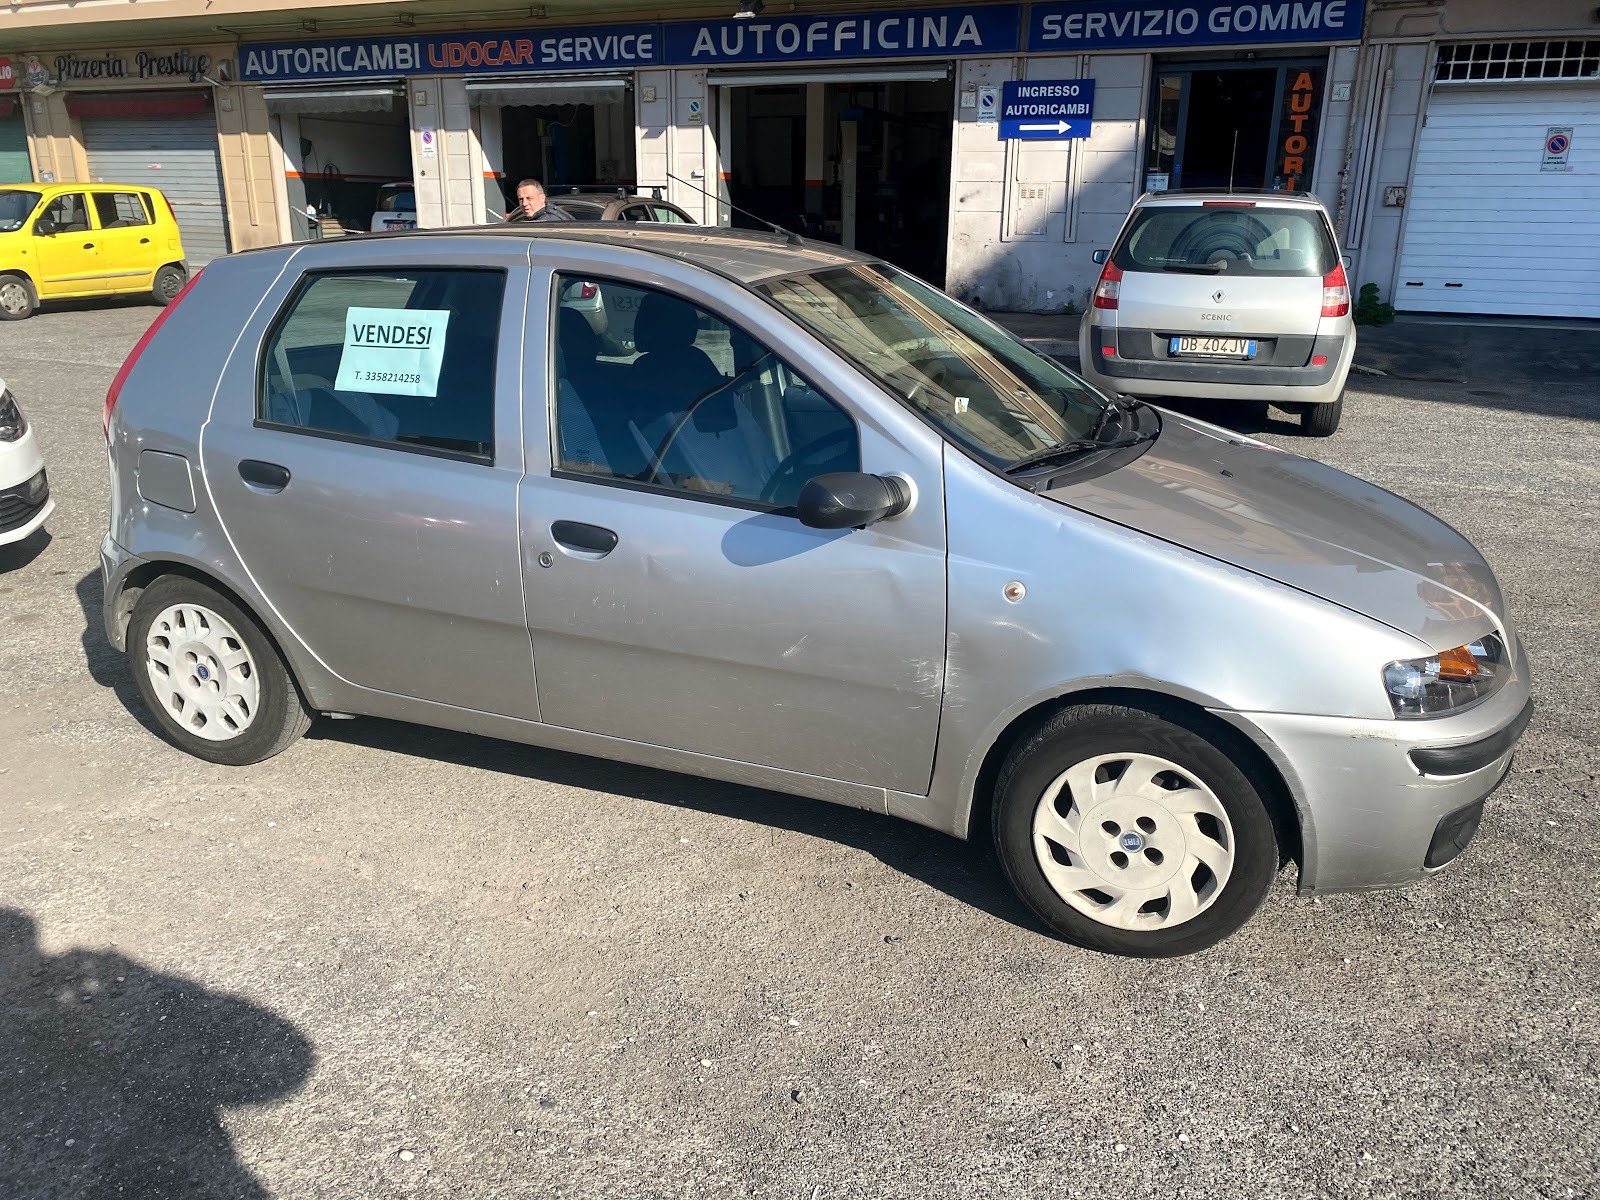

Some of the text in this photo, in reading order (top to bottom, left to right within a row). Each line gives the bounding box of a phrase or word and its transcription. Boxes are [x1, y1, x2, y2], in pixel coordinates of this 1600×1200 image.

[1042, 1, 1347, 40] SERVIZIO GOMME
[691, 15, 983, 57] AUTOFFICINA
[245, 34, 653, 76] AUTORICAMBI LIDOCAR SERVICE
[54, 50, 210, 82] Pizzeria Prestige
[1018, 85, 1080, 98] INGRESSO
[1334, 86, 1349, 98] 47
[962, 94, 974, 105] 46
[1005, 104, 1090, 116] AUTORICAMBI
[1283, 72, 1314, 192] AUTORI
[1200, 313, 1232, 321] SCENIC
[352, 323, 433, 345] VENDESI
[1181, 338, 1249, 353] DB 404JV
[355, 371, 421, 384] T. 3358214258
[1124, 838, 1140, 846] FIAT
